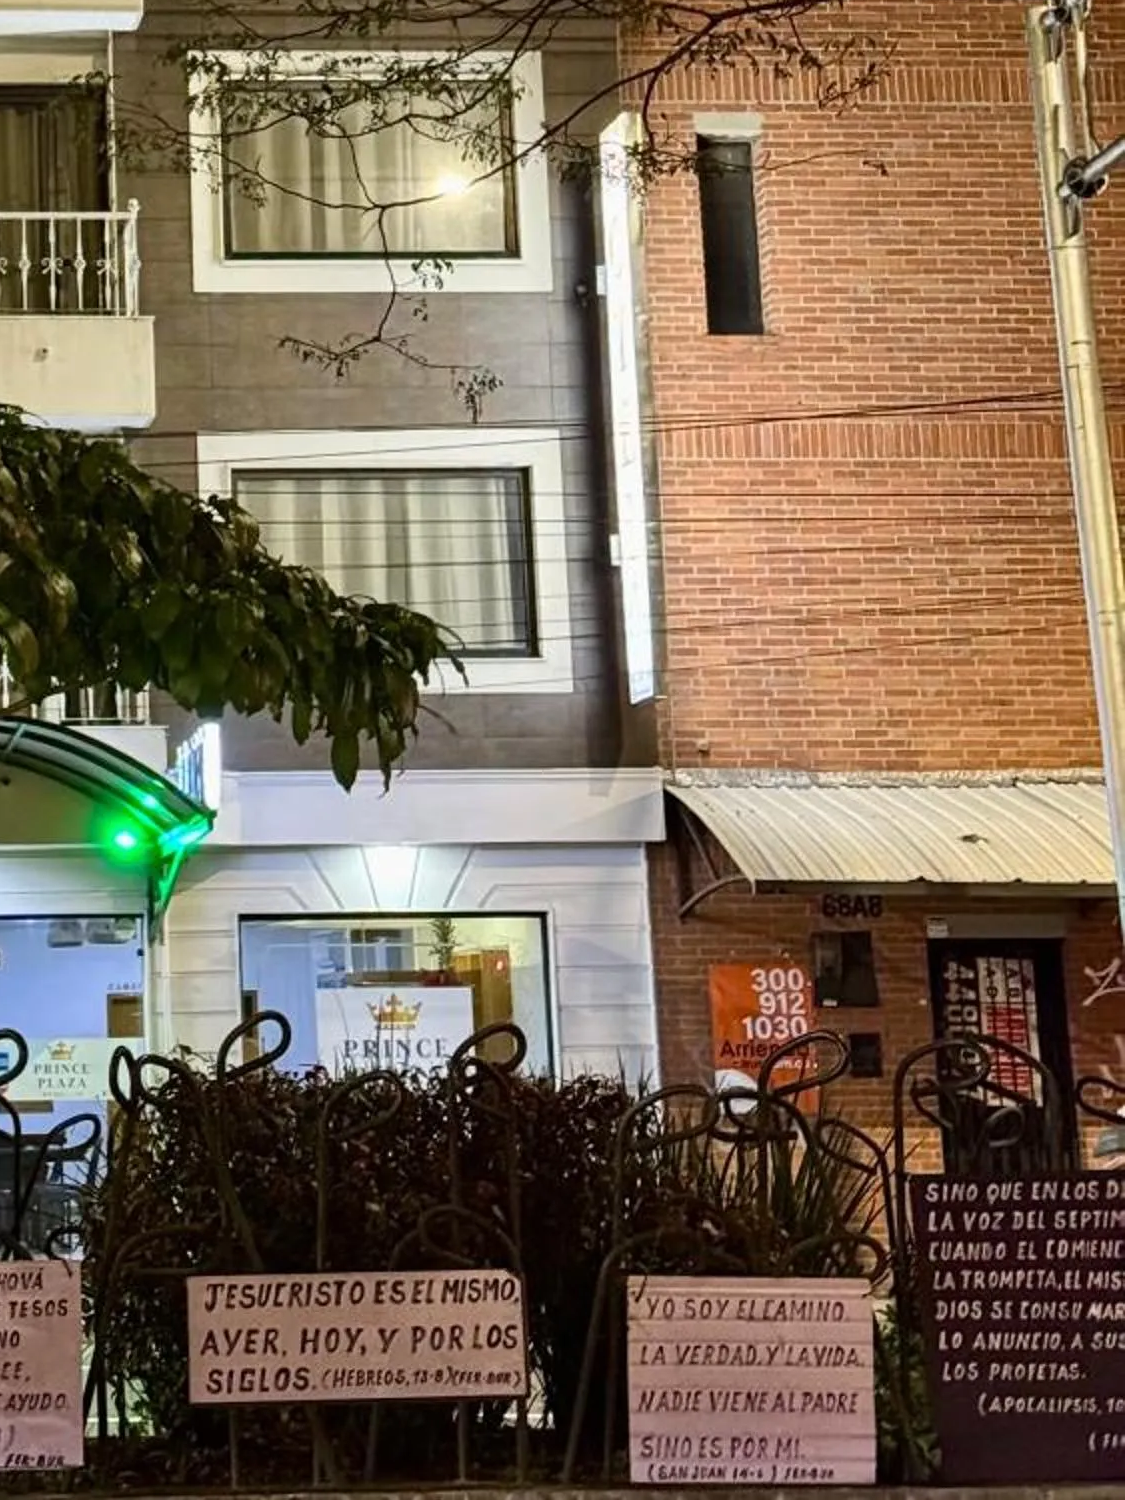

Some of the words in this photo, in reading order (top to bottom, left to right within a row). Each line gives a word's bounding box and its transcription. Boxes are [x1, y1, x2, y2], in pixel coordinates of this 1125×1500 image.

[751, 969, 804, 991] 300
[760, 992, 806, 1015] 912
[742, 1017, 807, 1039] 1030
[345, 1038, 446, 1058] PRINCE
[38, 1078, 86, 1089] PLAZA
[925, 1183, 977, 1202] SINO
[987, 1182, 1023, 1204] QUE
[1033, 1182, 1061, 1200] EN
[1064, 1181, 1099, 1200] LOS
[928, 1211, 954, 1232] LA
[963, 1212, 1005, 1230] VOZ
[1013, 1210, 1045, 1230] DEL
[929, 1241, 1006, 1261] CUANDO
[1017, 1241, 1037, 1260] EL
[934, 1270, 955, 1291] LA
[1065, 1270, 1081, 1290] EL
[205, 1281, 365, 1312] JESUCRISTO
[374, 1280, 406, 1304] ES
[411, 1280, 435, 1303] EL
[645, 1298, 675, 1319] YO
[683, 1298, 729, 1320] SOY
[736, 1300, 755, 1320] EL
[935, 1300, 982, 1320] DIOS
[991, 1300, 1012, 1320] SE
[379, 1329, 399, 1353] Y
[411, 1325, 464, 1353] POR
[474, 1324, 518, 1350] LOS
[939, 1331, 963, 1350] LO
[639, 1346, 666, 1365] LA
[943, 1362, 979, 1382] LOS
[637, 1390, 702, 1412] NADIE
[709, 1391, 769, 1412] VIENE
[770, 1392, 796, 1413] AL
[801, 1392, 859, 1414] PADRE
[640, 1436, 691, 1459] SINO
[698, 1437, 723, 1459] ES
[730, 1436, 768, 1459] POR
